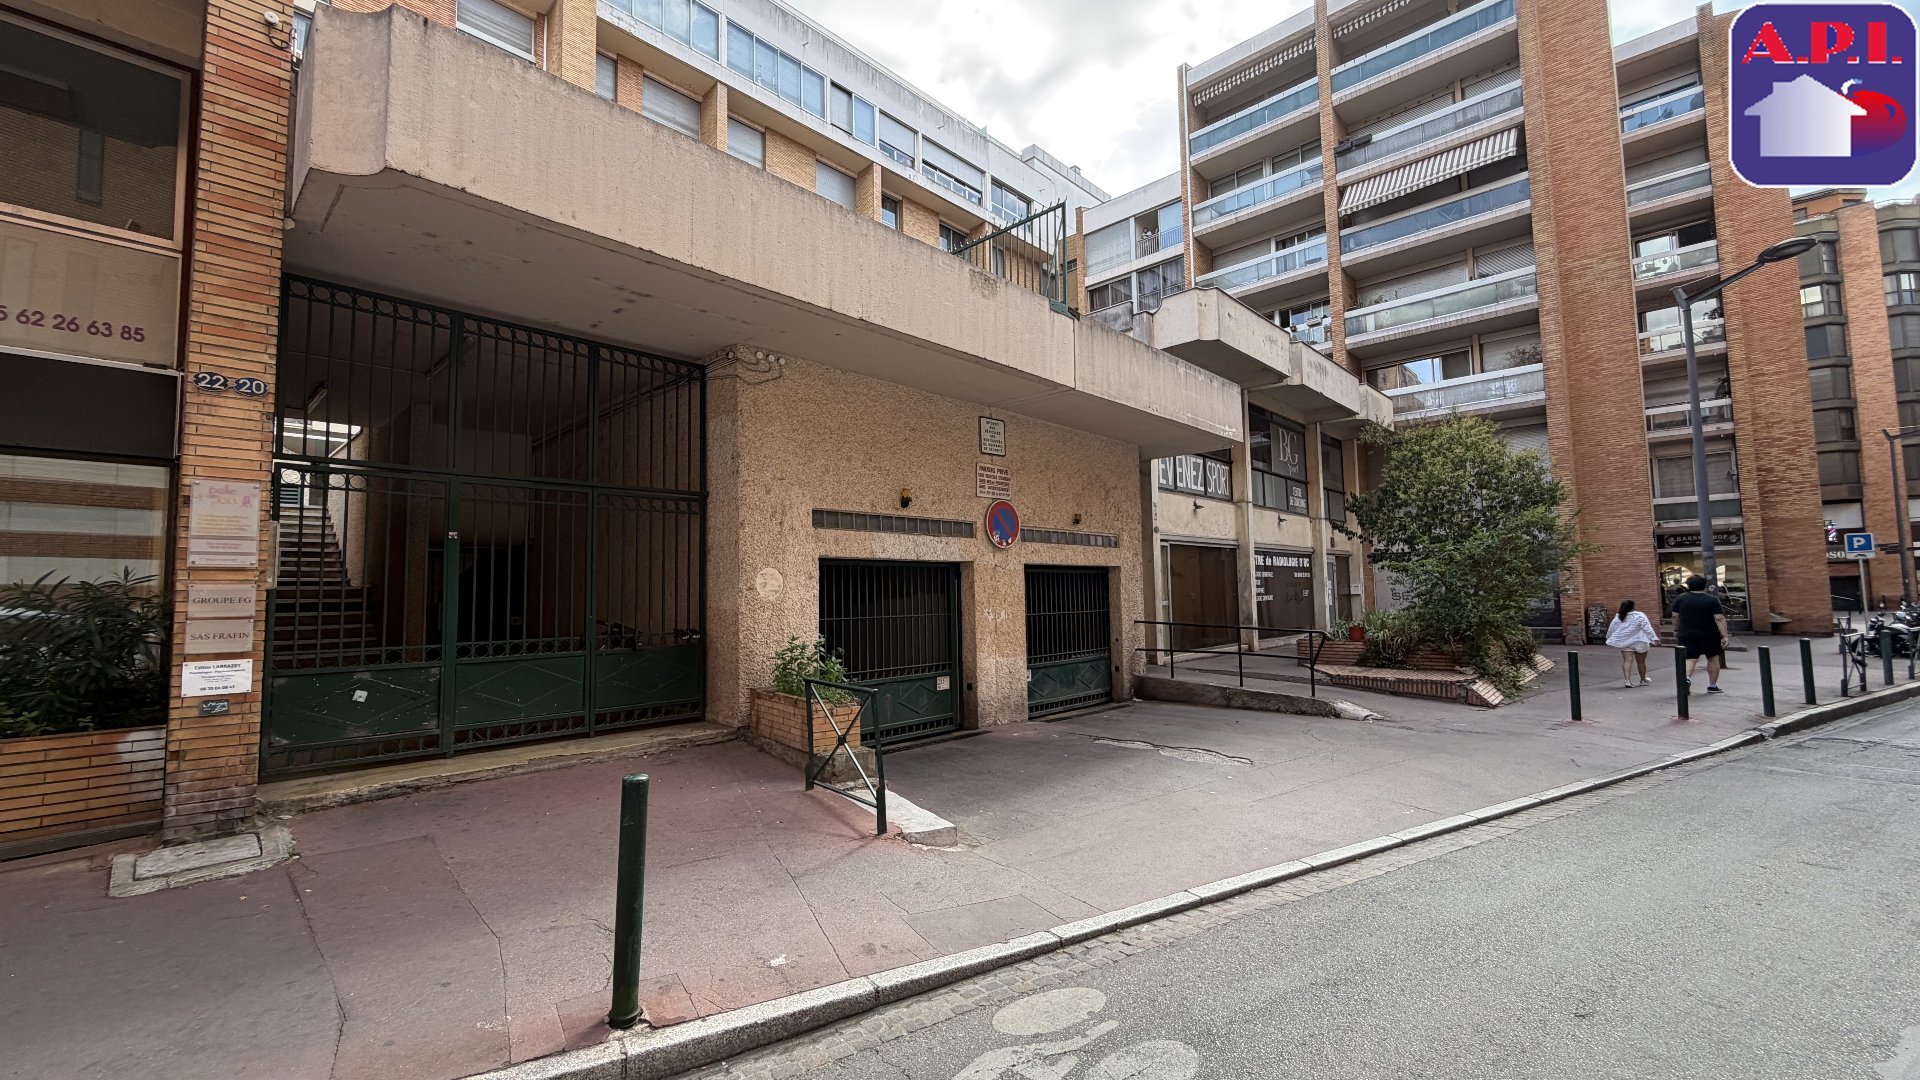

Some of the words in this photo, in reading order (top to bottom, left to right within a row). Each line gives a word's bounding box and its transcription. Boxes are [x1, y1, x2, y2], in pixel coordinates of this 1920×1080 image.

[16, 309, 45, 327] 62
[52, 313, 80, 333] 26
[87, 320, 112, 337] 63
[120, 325, 145, 342] 85
[198, 373, 225, 389] 22
[239, 379, 265, 394] 20
[1278, 428, 1299, 465] BG
[1206, 461, 1230, 495] SPORT
[1853, 537, 1866, 549] P
[192, 596, 236, 605] GROUPE
[238, 596, 252, 604] FG
[190, 633, 210, 641] SAS
[212, 632, 250, 640] FRAFIN
